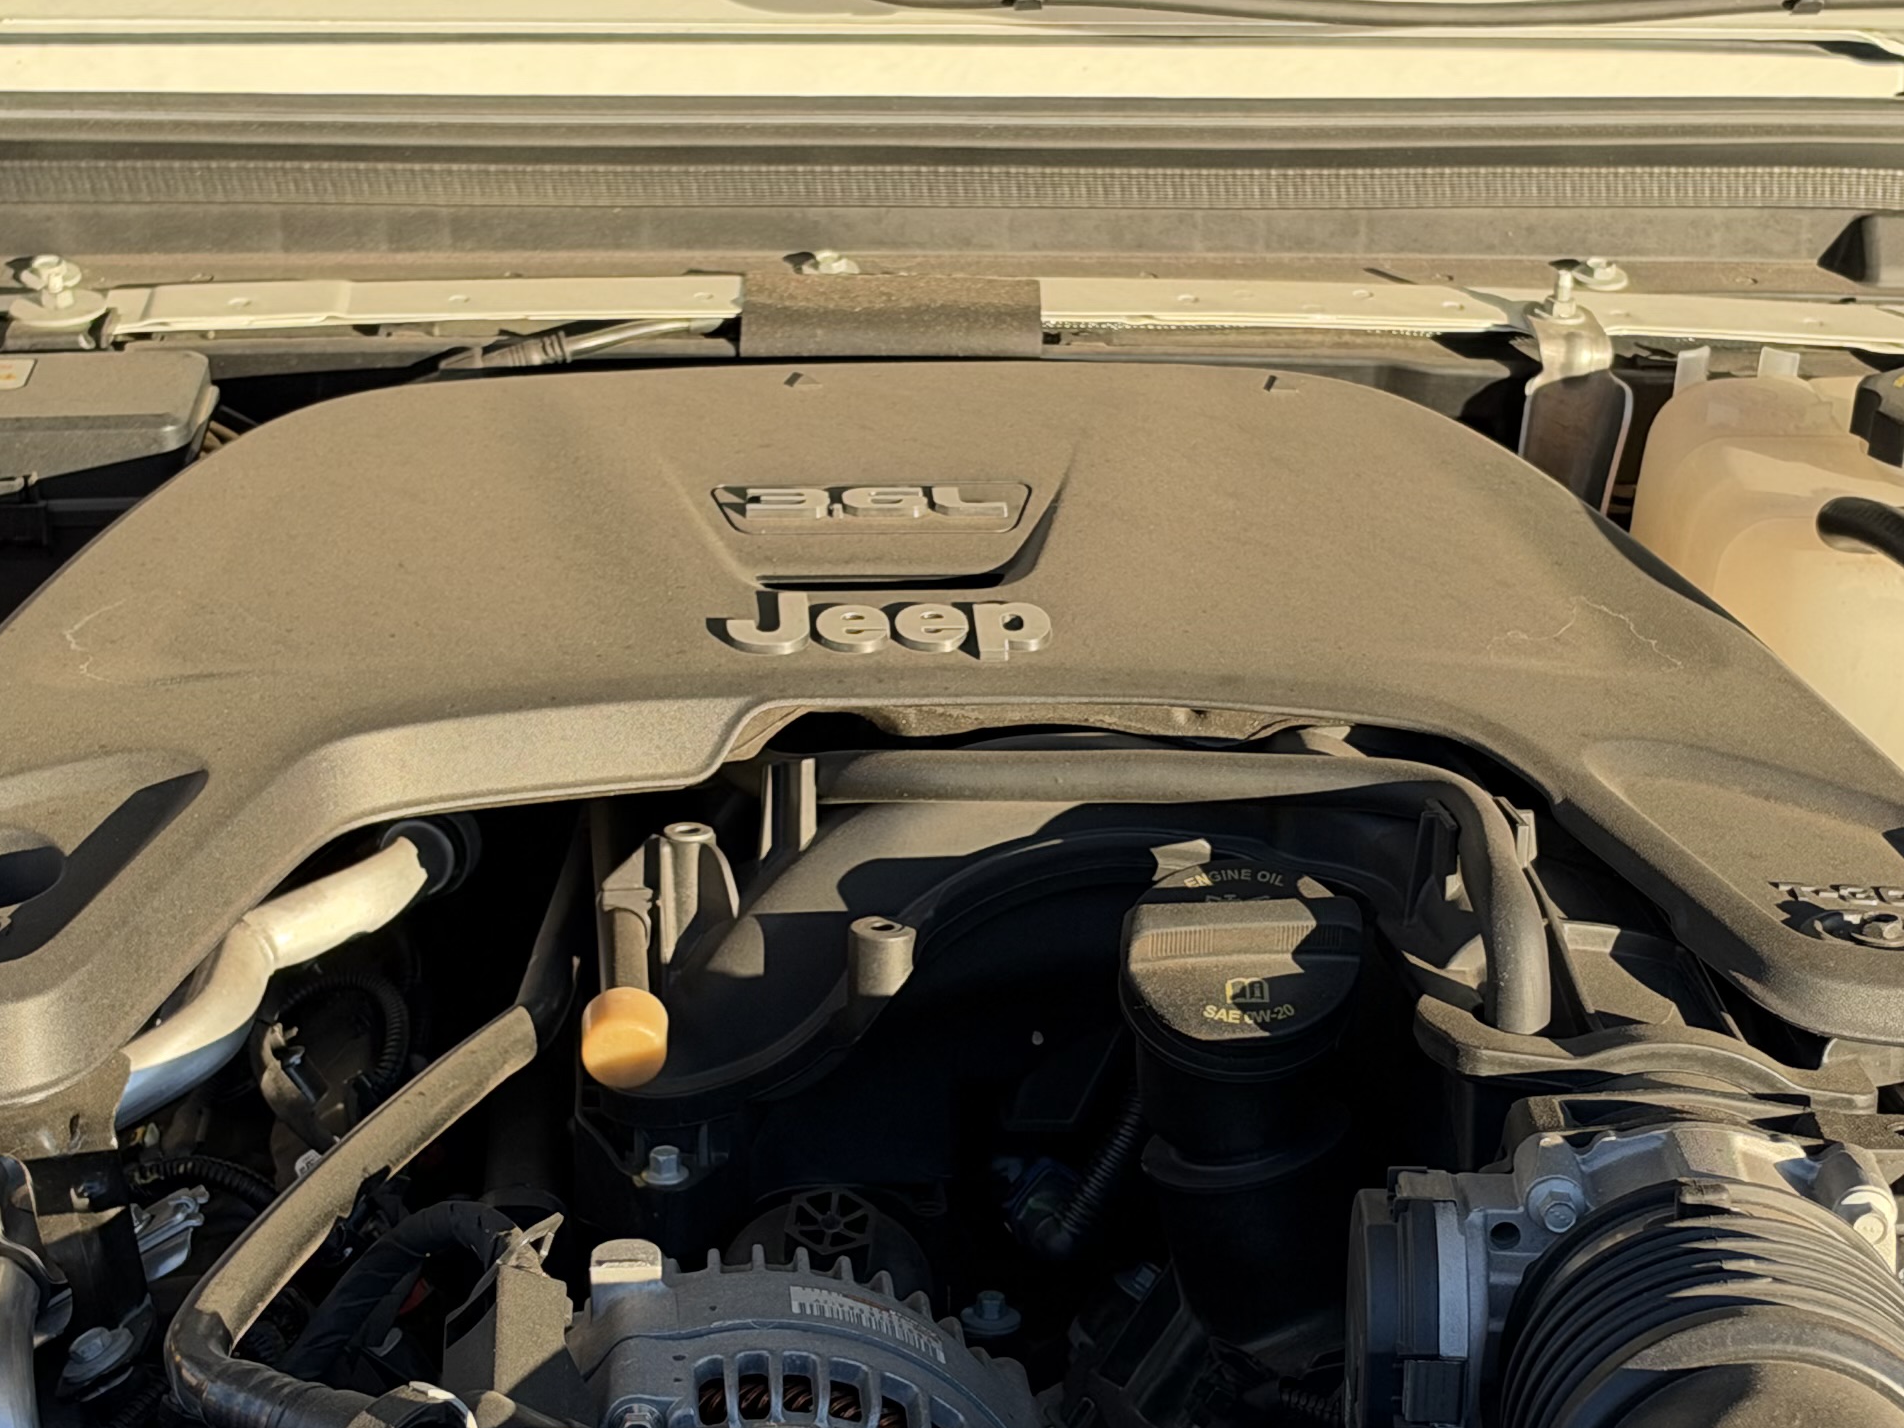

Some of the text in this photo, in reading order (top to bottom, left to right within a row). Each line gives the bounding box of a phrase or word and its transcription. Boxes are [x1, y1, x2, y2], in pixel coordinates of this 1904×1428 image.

[744, 486, 1010, 522] 3.6L
[724, 591, 1053, 662] Jeep
[1183, 869, 1285, 888] ENGINE OIL
[1203, 1003, 1295, 1024] SAE 0W-20
